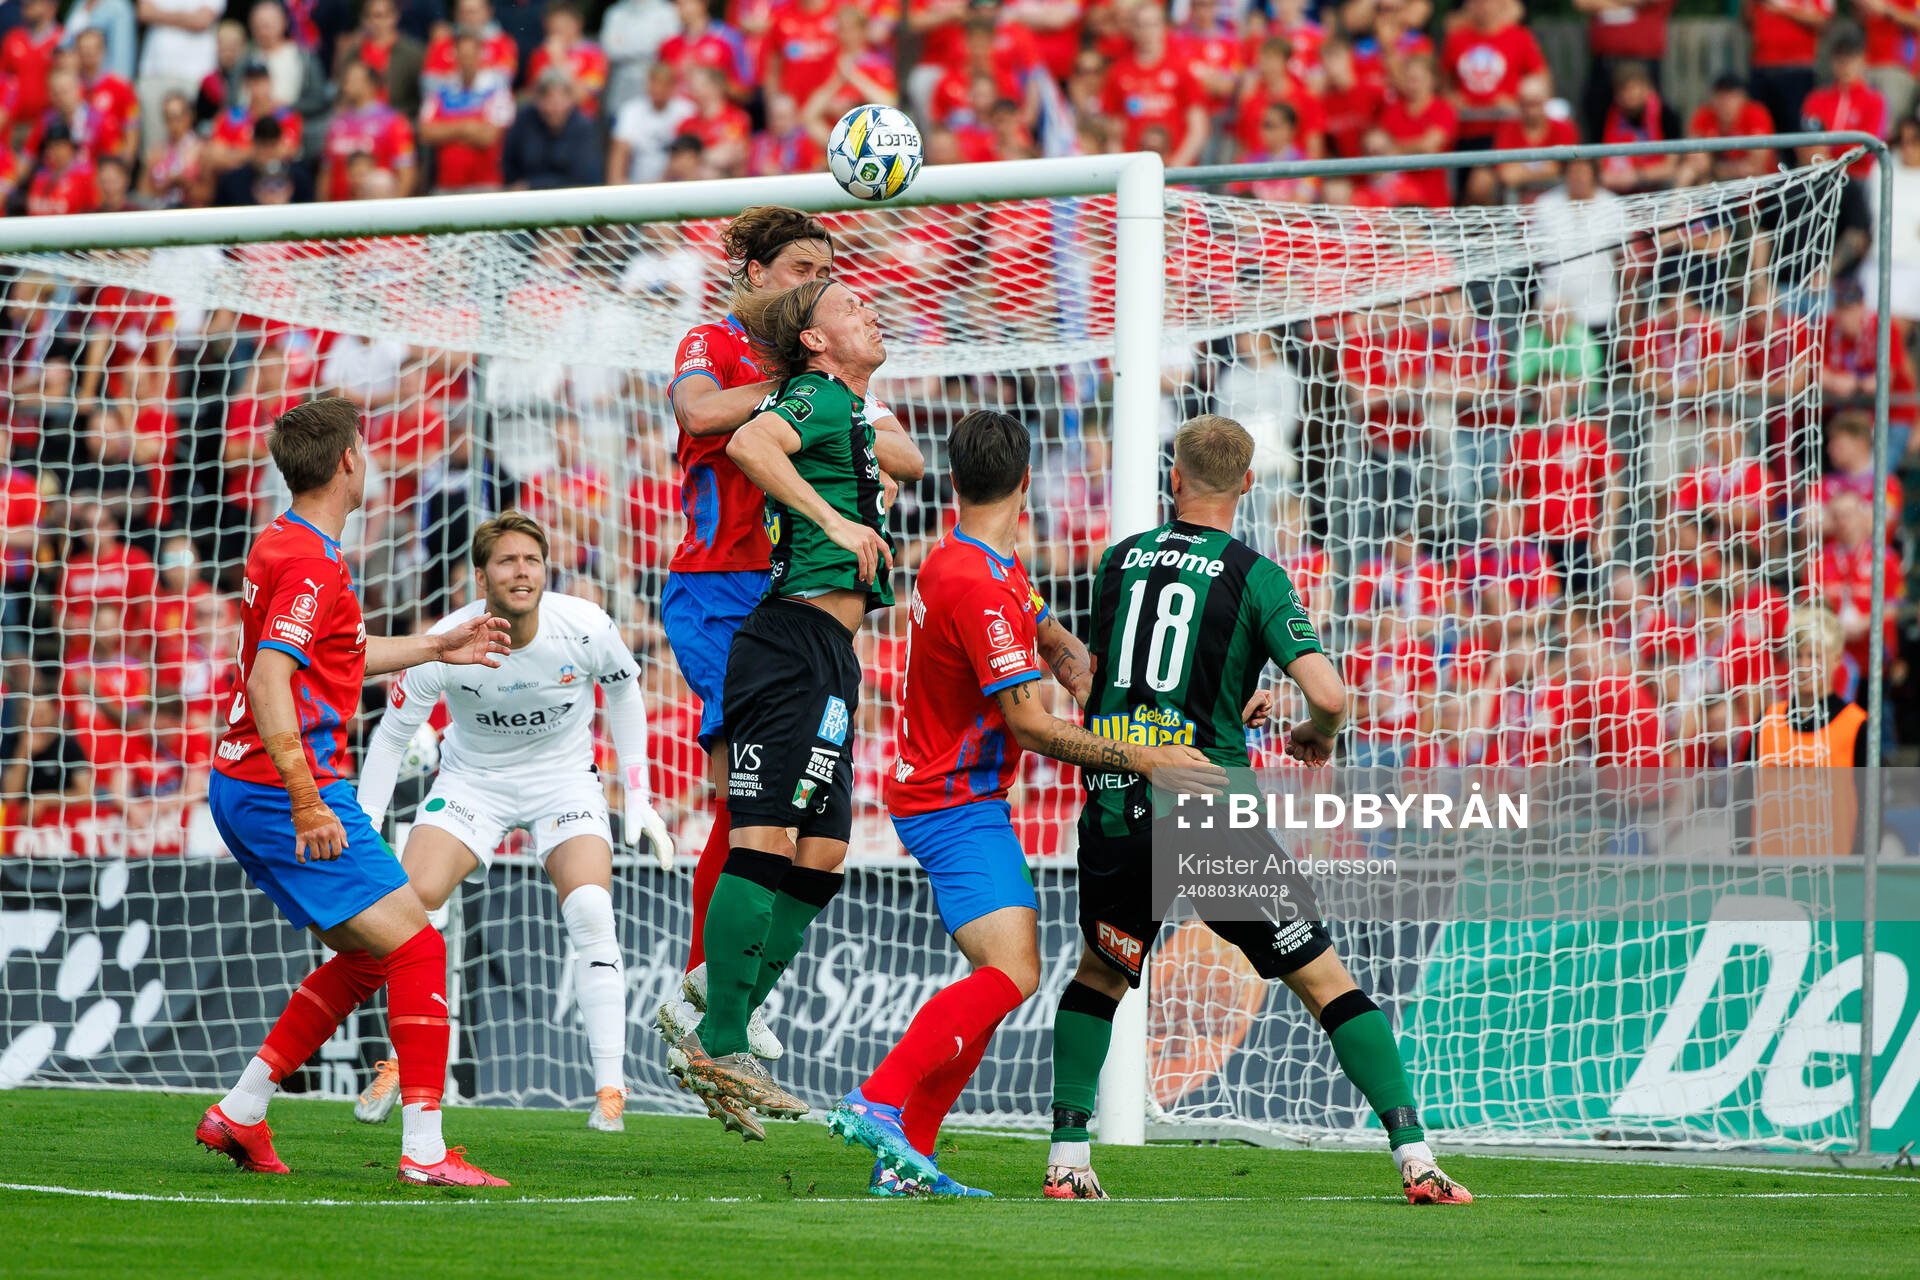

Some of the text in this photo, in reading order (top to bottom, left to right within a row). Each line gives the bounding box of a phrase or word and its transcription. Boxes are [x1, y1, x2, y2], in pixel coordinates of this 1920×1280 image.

[876, 134, 918, 148] SELECT
[1121, 547, 1225, 577] Derome
[275, 620, 313, 642] UNIBET
[1114, 578, 1196, 692] 18
[989, 649, 1028, 669] UNIBET
[598, 669, 631, 684] XXL
[476, 710, 546, 728] akea
[1133, 703, 1181, 728] Gekås
[733, 742, 764, 771] VS
[807, 761, 834, 778] BYGG
[745, 789, 757, 798] SPA
[447, 800, 476, 822] Solid
[1260, 888, 1299, 928] VS
[1271, 921, 1314, 950] STADSHOTELL
[1274, 917, 1306, 941] VARBERGS
[1099, 922, 1141, 959] FMP
[1287, 938, 1303, 953] ASIA
[1301, 931, 1314, 944] SPA
